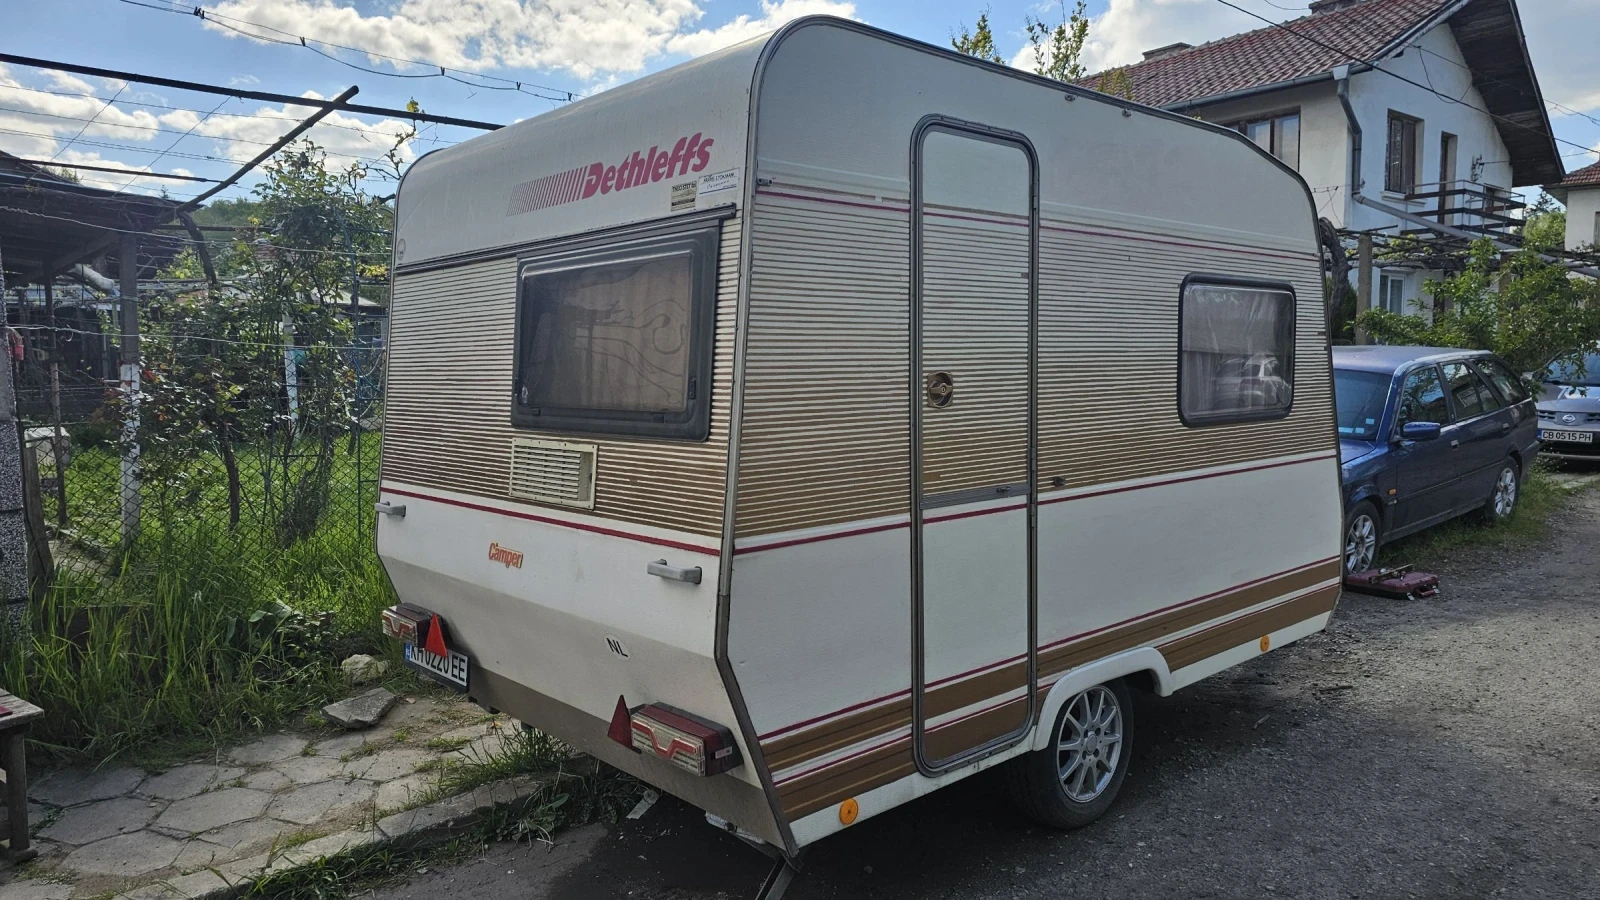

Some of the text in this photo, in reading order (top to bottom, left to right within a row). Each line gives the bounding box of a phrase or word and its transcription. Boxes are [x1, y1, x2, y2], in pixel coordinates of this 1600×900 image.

[582, 132, 714, 199] Dethleffs
[1543, 431, 1592, 442] CB 0515 PH
[488, 542, 523, 569] Camper
[606, 637, 629, 658] NL
